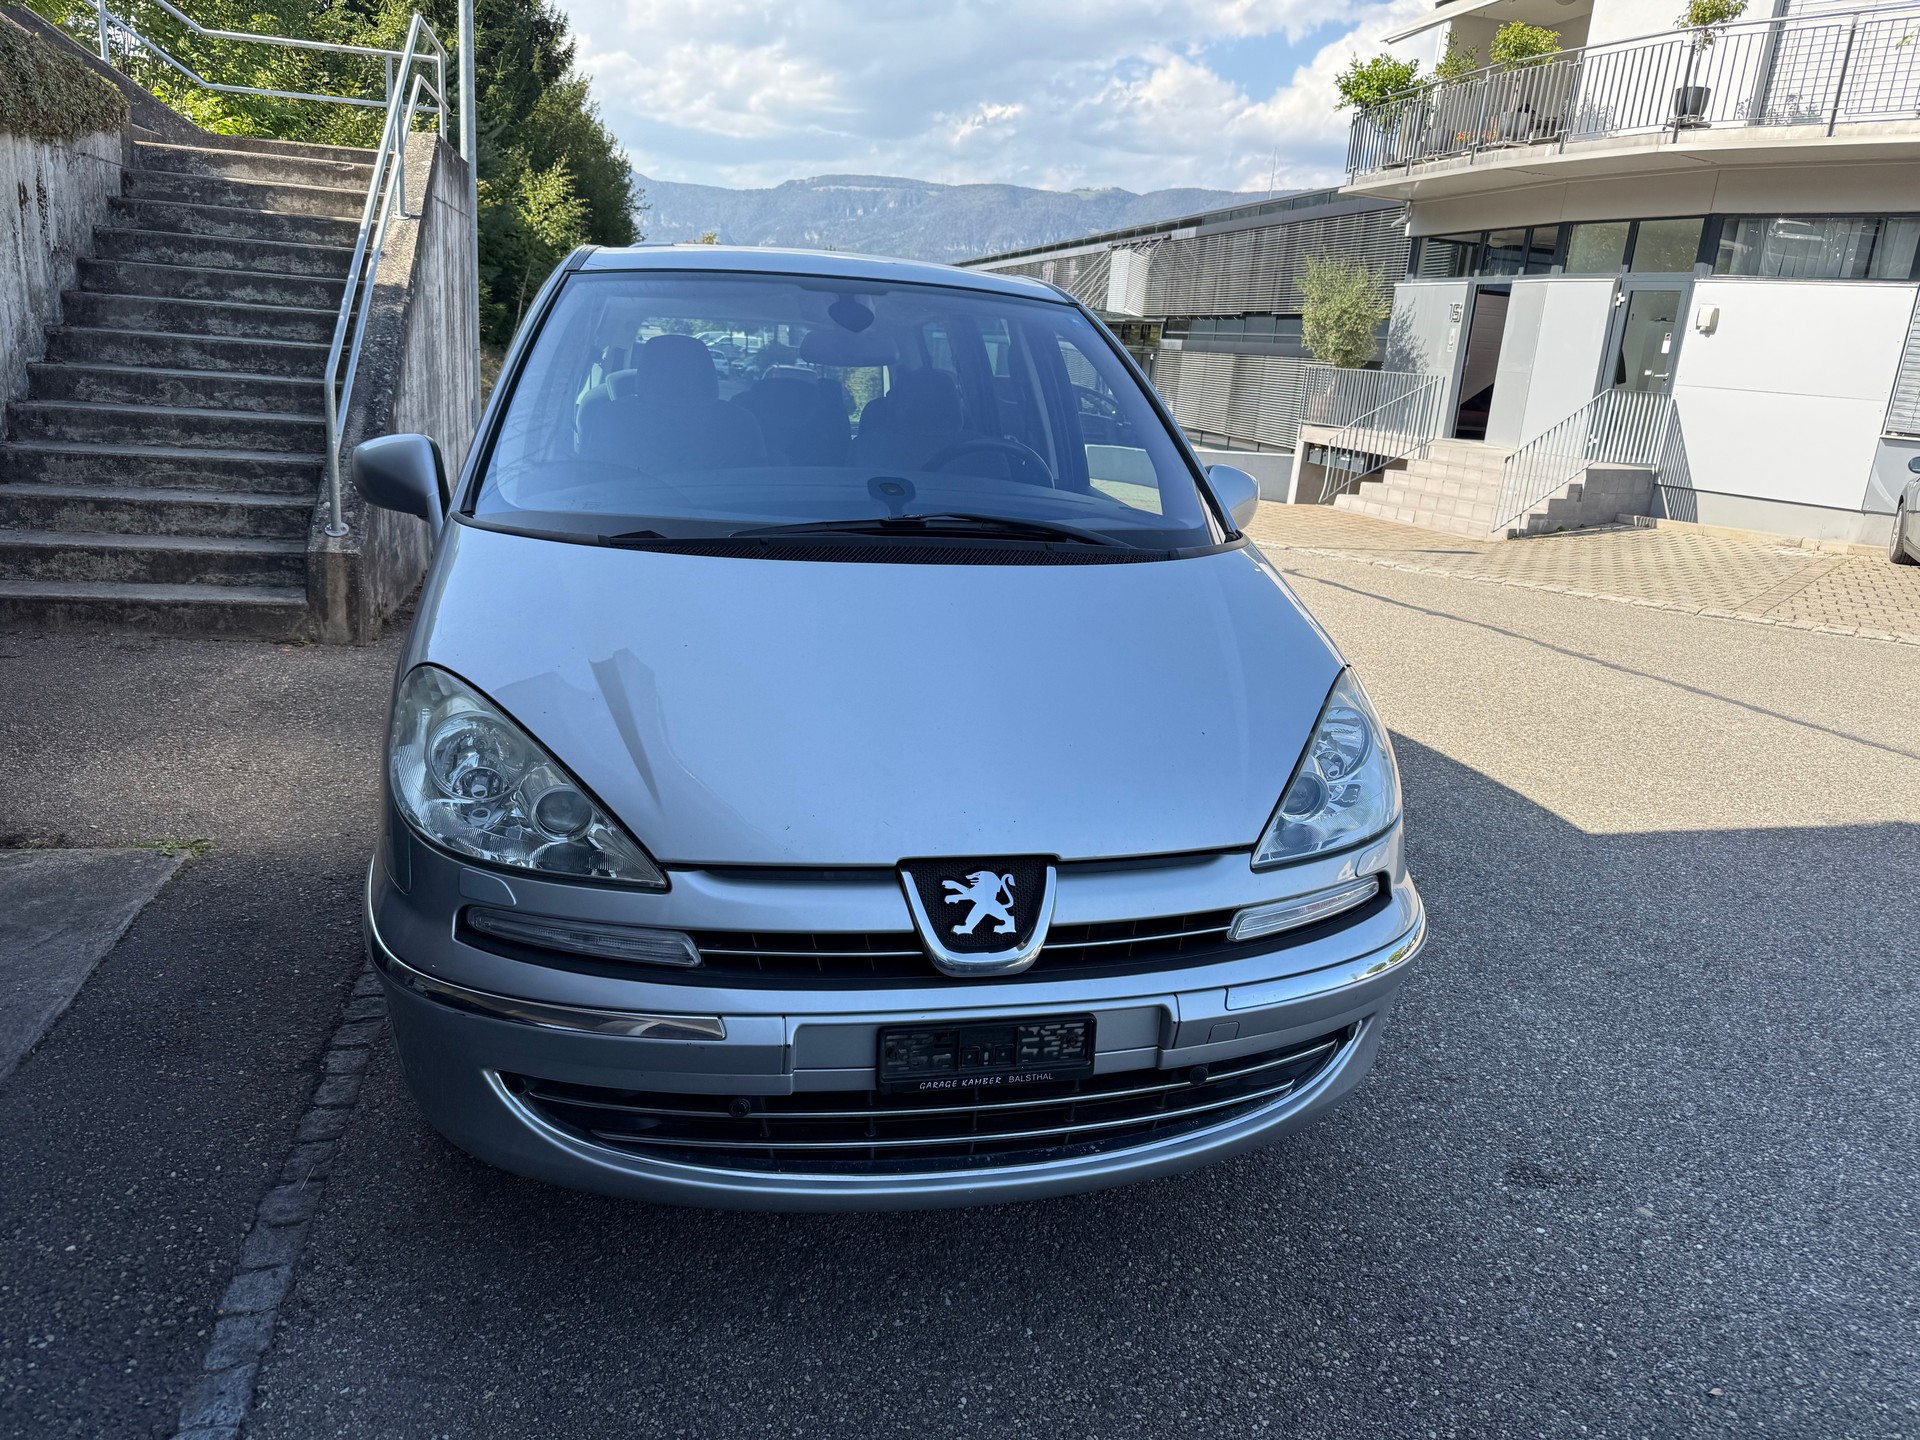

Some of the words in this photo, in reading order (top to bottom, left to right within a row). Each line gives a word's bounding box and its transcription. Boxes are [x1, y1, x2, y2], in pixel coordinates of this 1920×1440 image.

[1449, 303, 1463, 323] 15
[919, 1079, 958, 1090] GARAGE
[961, 1076, 1002, 1087] KAMBER
[1008, 1073, 1054, 1083] BALSTHAL
